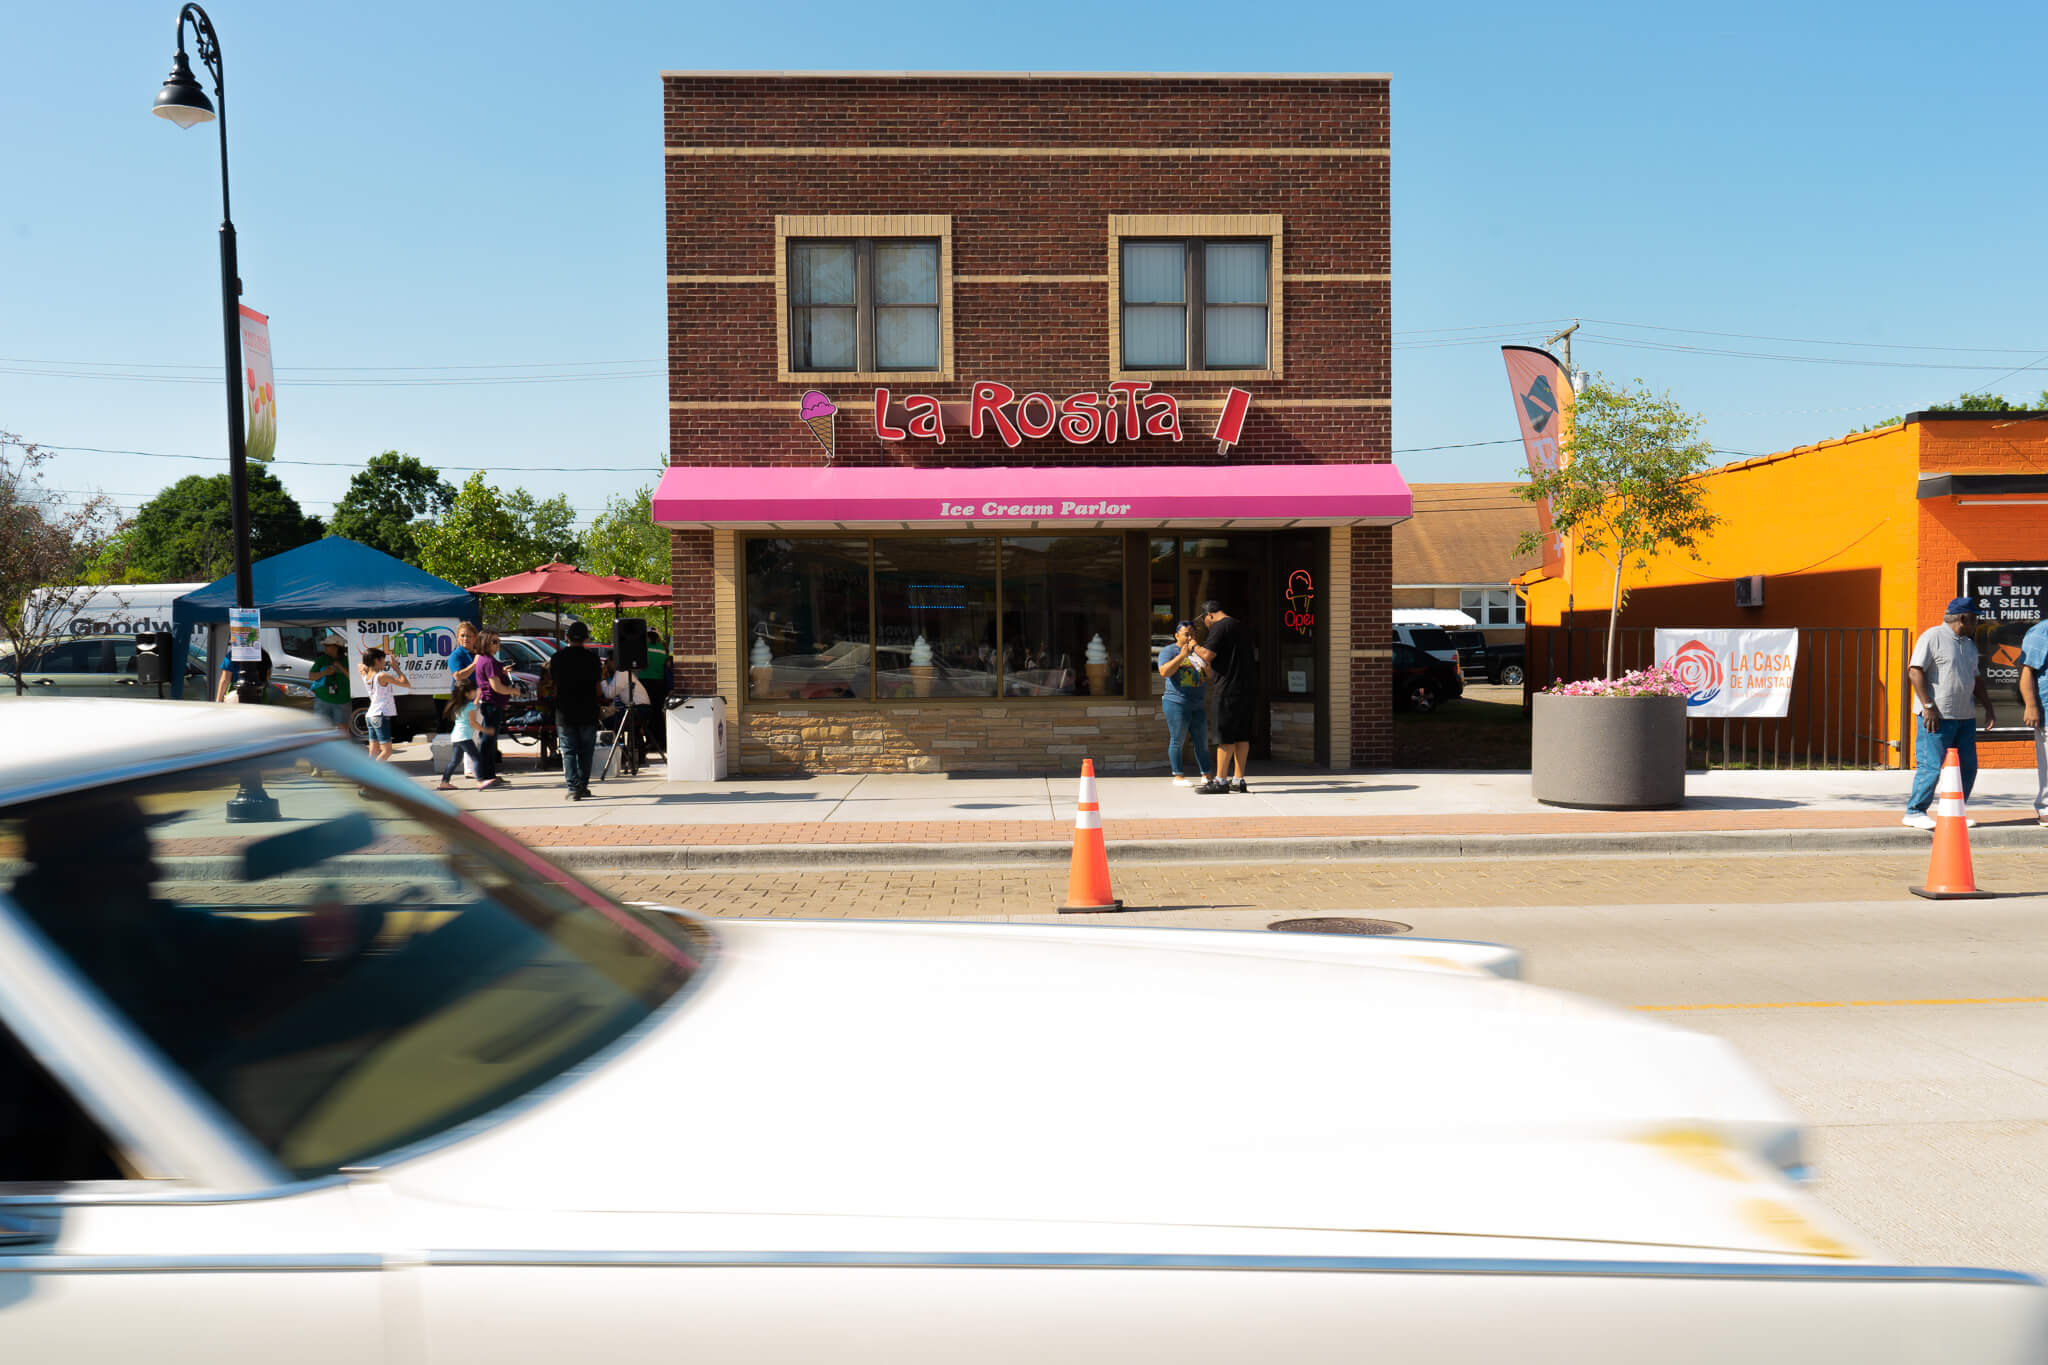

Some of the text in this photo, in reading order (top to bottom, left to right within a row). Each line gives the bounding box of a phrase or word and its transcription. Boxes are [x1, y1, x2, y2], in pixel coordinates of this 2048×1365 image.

[875, 388, 946, 445] La
[940, 500, 1132, 517] Ice Cream Parlor
[1977, 586, 2042, 596] WE BUY
[1979, 598, 2039, 608] & SELL
[2001, 610, 2041, 620] PHONES
[358, 620, 405, 634] Sabor
[383, 632, 452, 658] LATINO
[404, 659, 433, 671] 106.5
[433, 659, 449, 671] FM
[1986, 666, 2020, 678] boos
